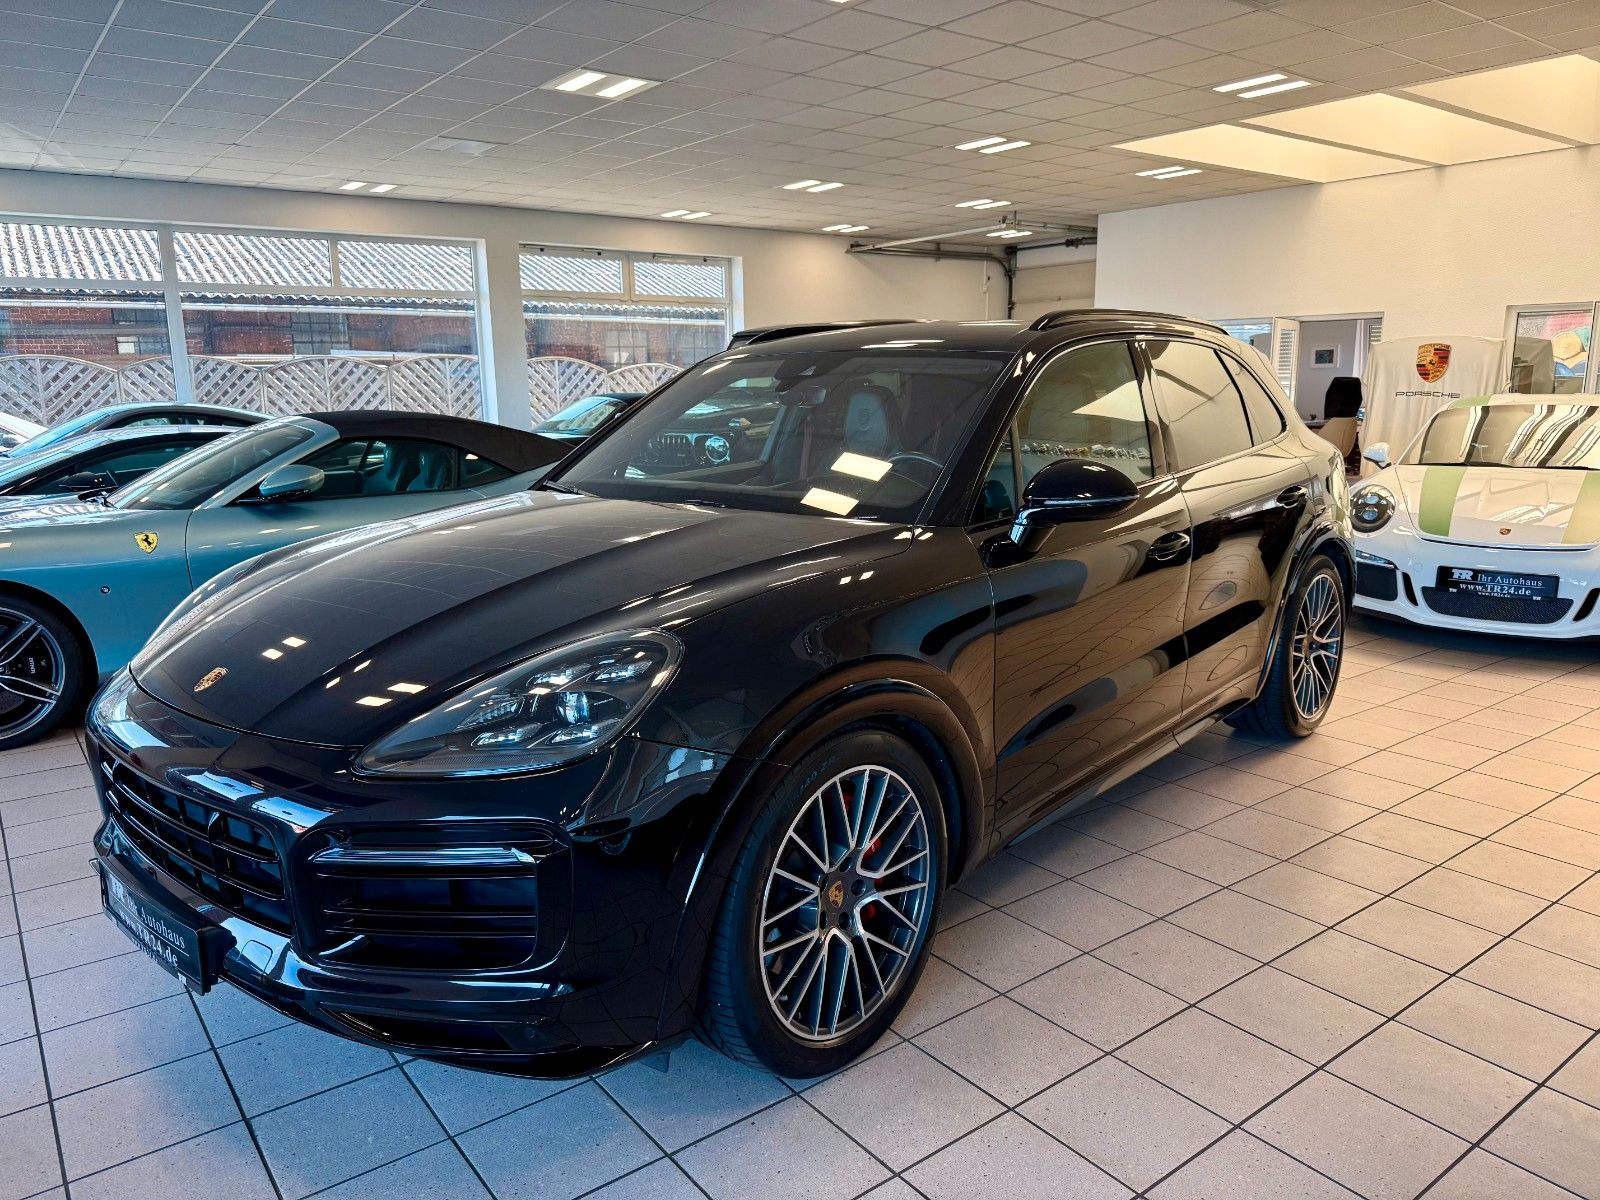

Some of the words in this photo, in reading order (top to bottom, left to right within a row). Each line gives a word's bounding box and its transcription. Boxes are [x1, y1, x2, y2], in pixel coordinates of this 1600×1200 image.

[1395, 390, 1460, 399] PORSCHE
[1477, 573, 1492, 582] Ihr
[1495, 575, 1543, 587] Autohaus
[1459, 583, 1532, 596] www.TR24.de
[127, 894, 138, 916] Ihr
[140, 906, 186, 949] Autohaus
[119, 909, 178, 967] www.TR24.de
